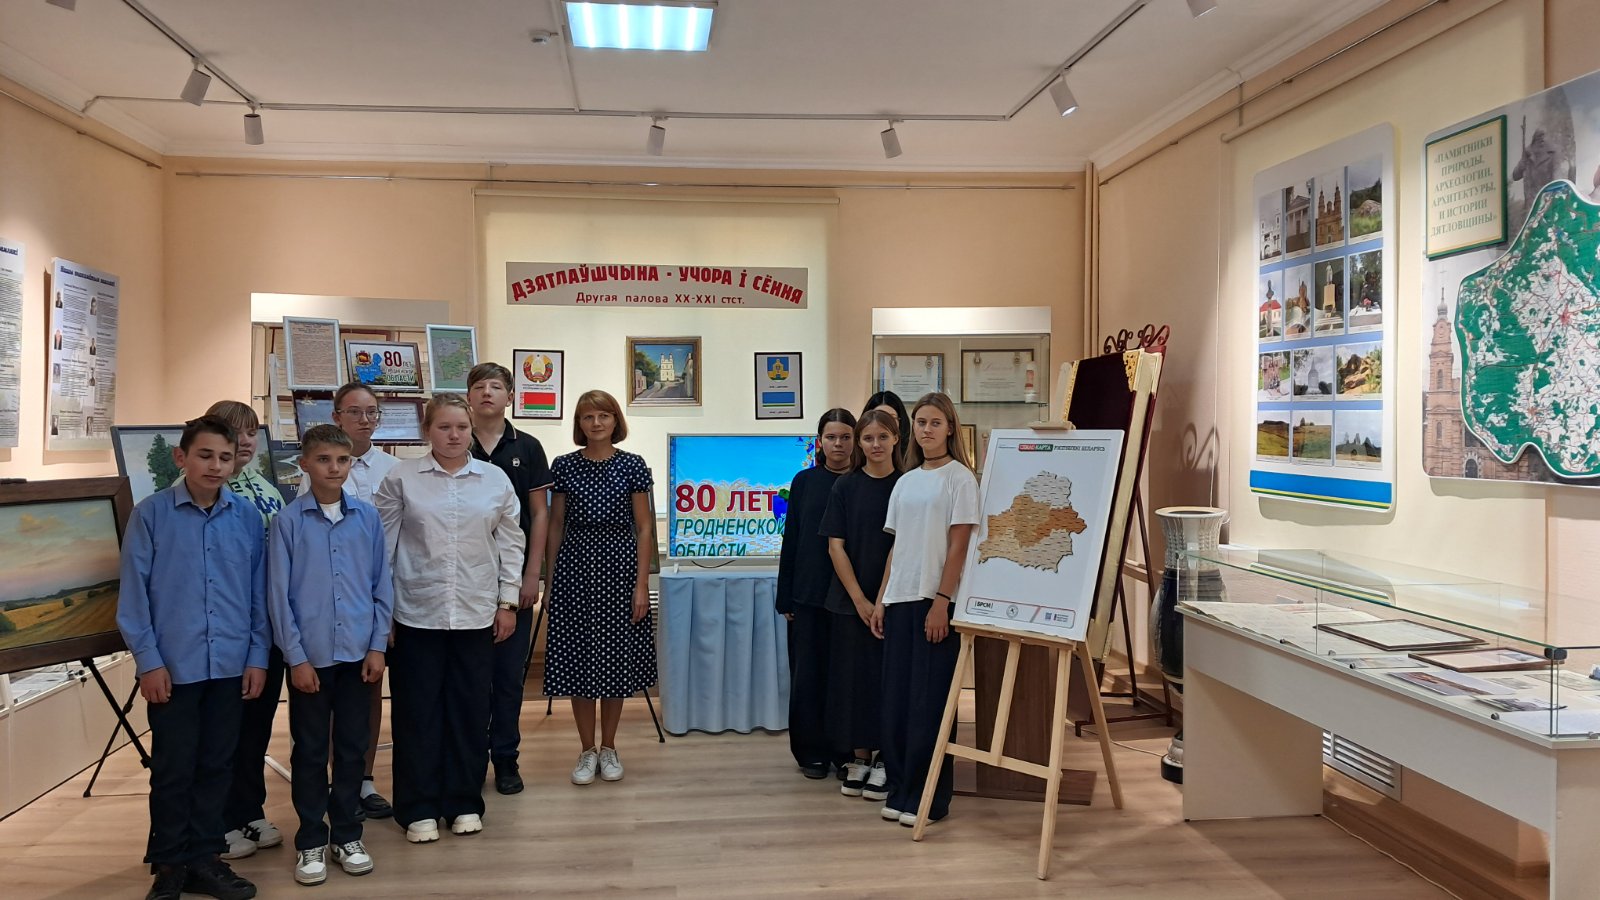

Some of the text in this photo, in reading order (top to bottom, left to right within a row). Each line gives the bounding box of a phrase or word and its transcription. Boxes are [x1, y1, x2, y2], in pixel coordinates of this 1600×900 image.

[1447, 198, 1488, 218] ИСТОРИИ
[511, 264, 659, 302] ДЗЯТЛАЎШЧЫНА
[679, 266, 733, 286] УЧОРА
[752, 274, 804, 305] СЁННЯ
[576, 292, 618, 304] Другая
[625, 295, 669, 304] палова
[721, 296, 746, 305] стст.
[384, 351, 402, 367] 80
[675, 484, 778, 513] 80 ЛЕТ
[675, 515, 786, 539] ГРОДНЕНСКОЙ
[675, 543, 747, 556] ОБЛАСТИ
